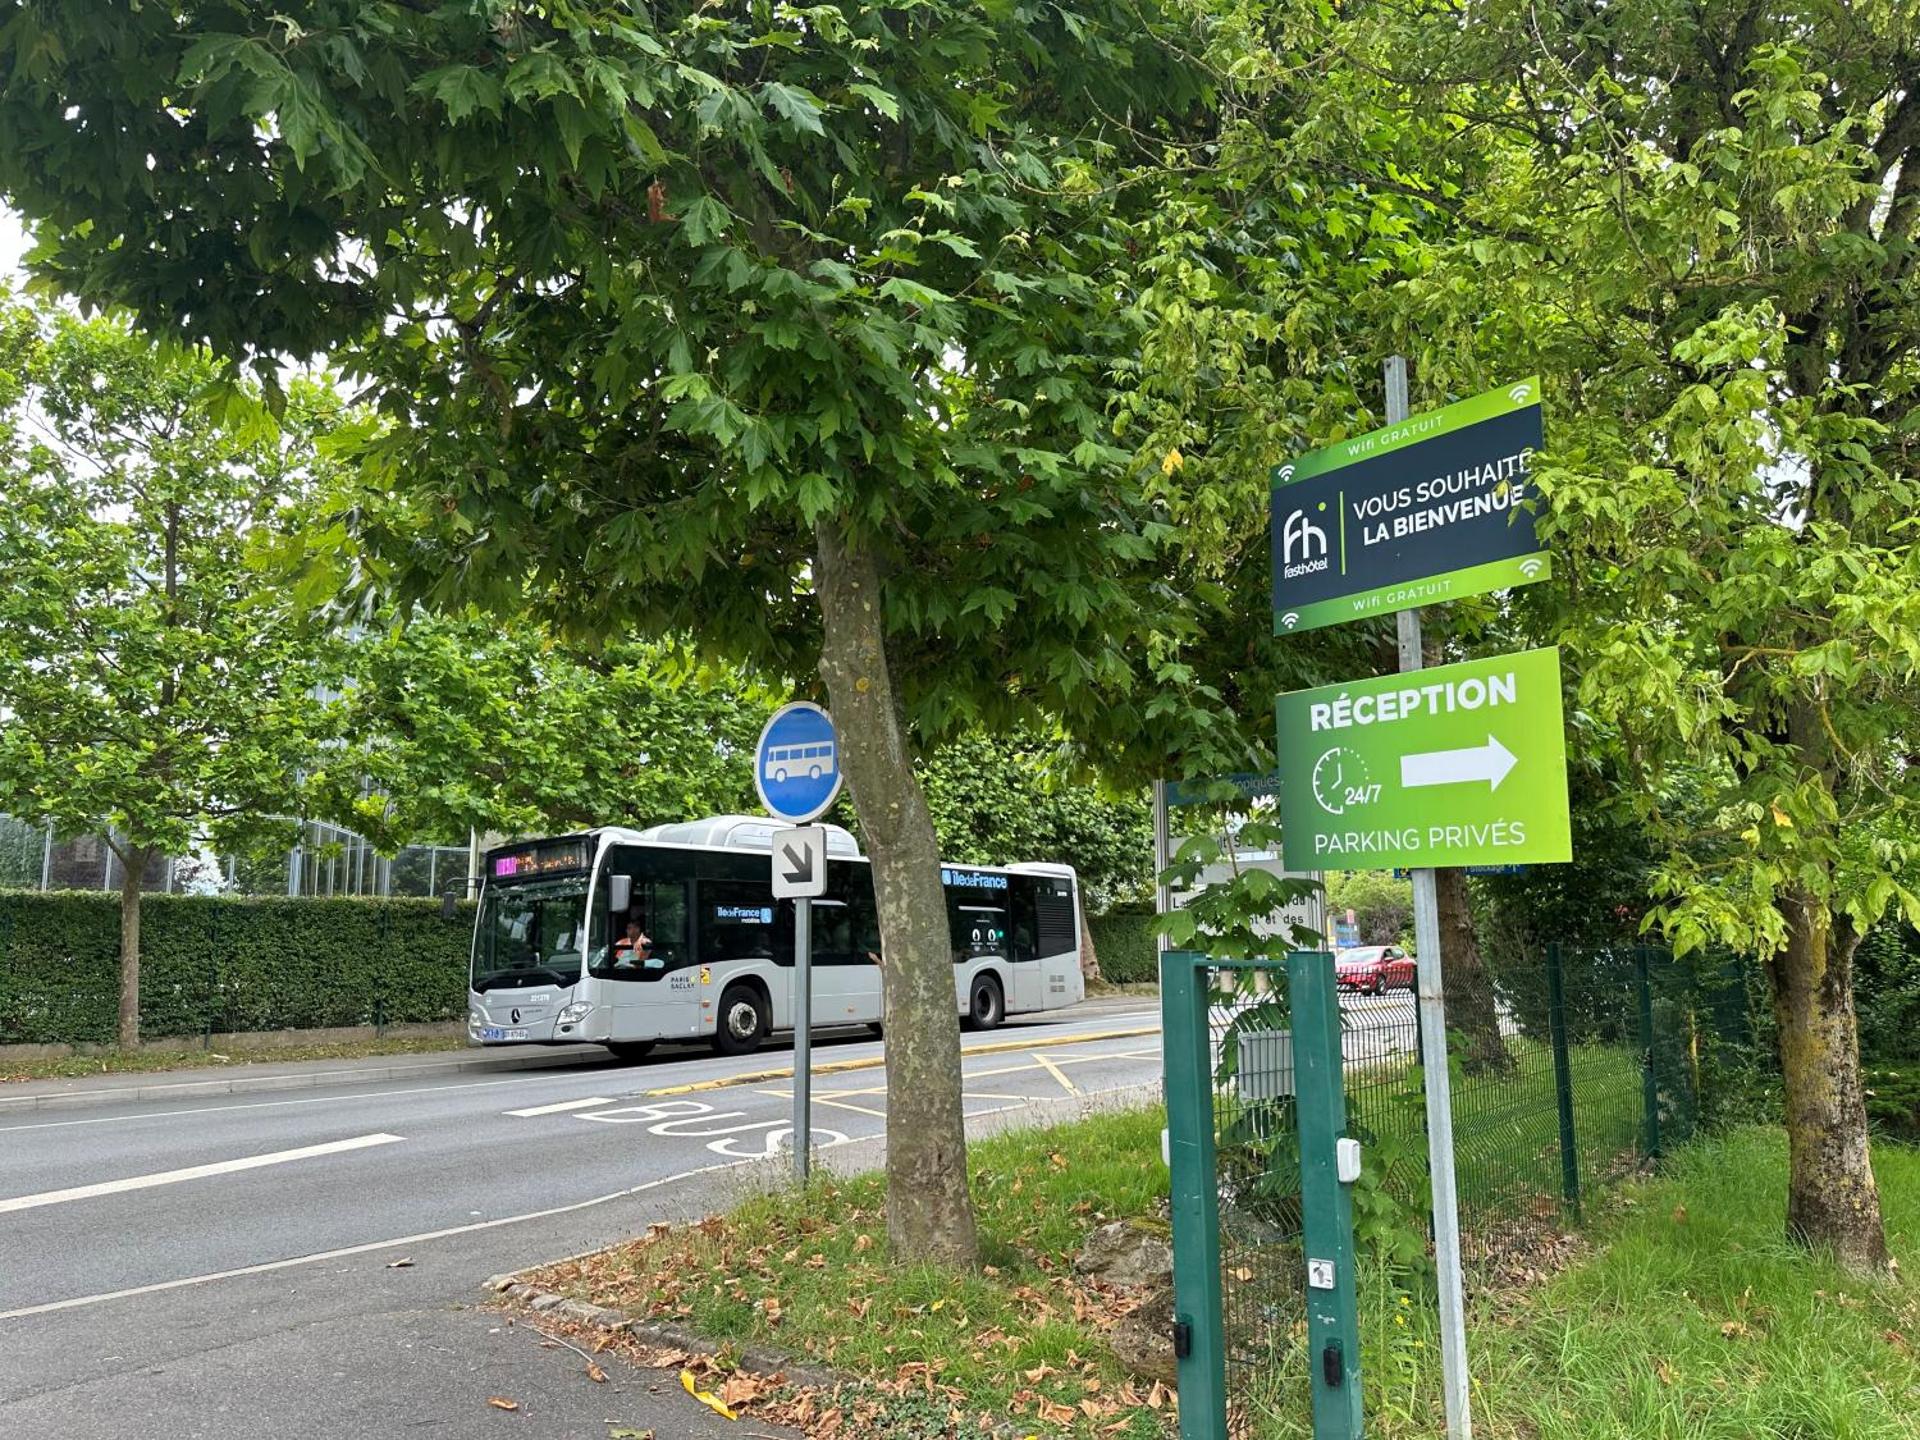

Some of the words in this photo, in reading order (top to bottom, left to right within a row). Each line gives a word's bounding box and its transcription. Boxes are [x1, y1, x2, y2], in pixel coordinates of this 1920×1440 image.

[1347, 438, 1375, 457] Wifi
[1380, 415, 1444, 446] GRATUIT
[1352, 489, 1412, 521] VOUS
[1363, 524, 1391, 547] LA
[1394, 483, 1525, 538] BIENVENUE
[1284, 557, 1329, 580] fasthôtel
[1352, 593, 1381, 612] Wifi
[1386, 579, 1452, 605] GRATUIT
[1309, 672, 1517, 732] RÉCEPTION
[1344, 784, 1382, 806] 24/7
[1315, 827, 1420, 855] PARKING
[1429, 818, 1526, 849] PRIVÉS
[1283, 913, 1304, 924] des
[572, 1100, 851, 1159] BUS
